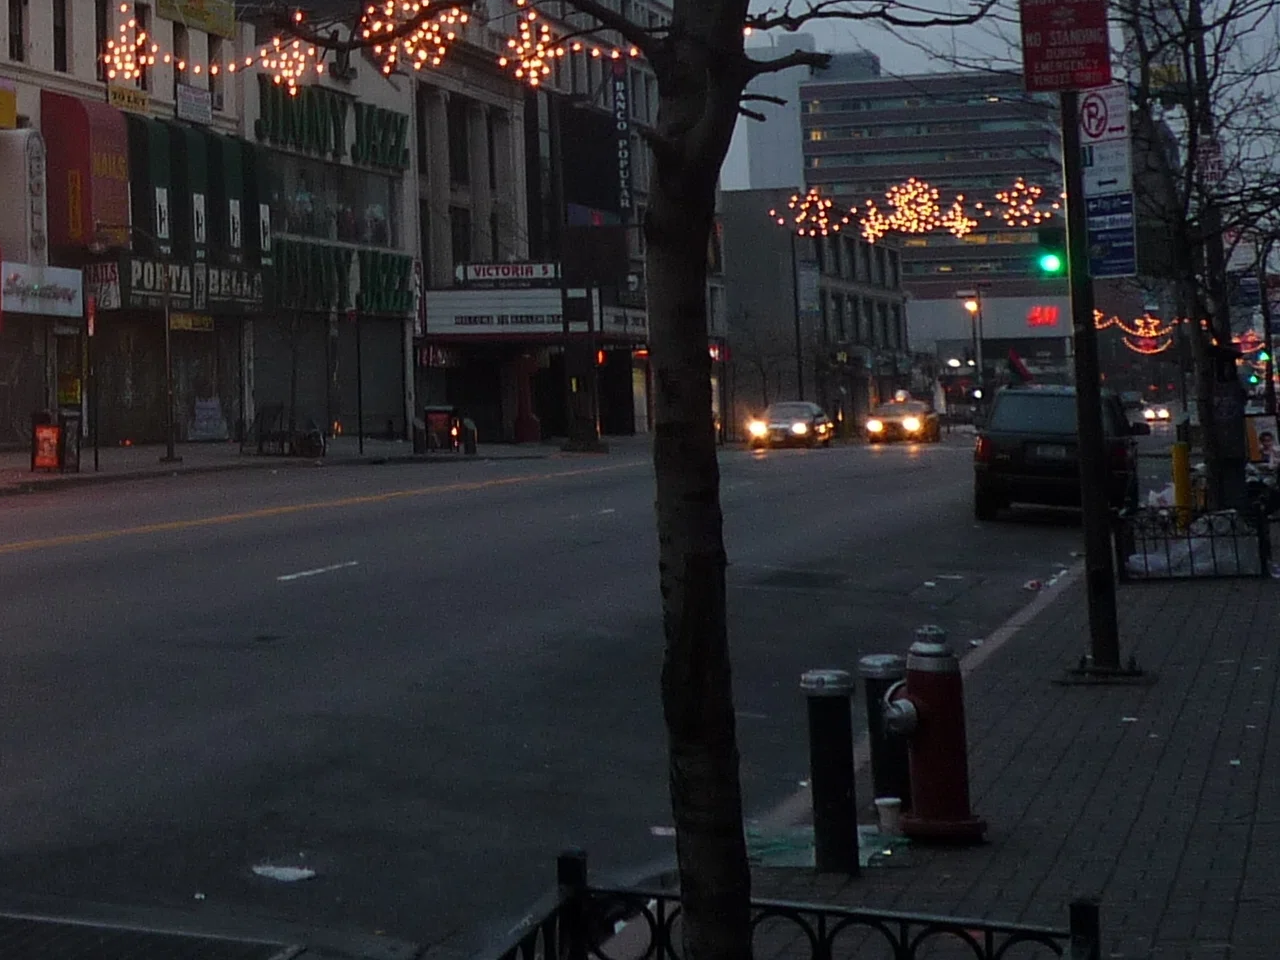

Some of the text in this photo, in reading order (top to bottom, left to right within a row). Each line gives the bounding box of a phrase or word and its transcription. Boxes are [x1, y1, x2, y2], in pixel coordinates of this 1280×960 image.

[1025, 28, 1105, 47] NO STANDING
[615, 81, 631, 208] BANCO POPULAR
[92, 152, 127, 180] NAILS
[131, 259, 192, 293] PORTA
[474, 264, 534, 277] VICTORIA
